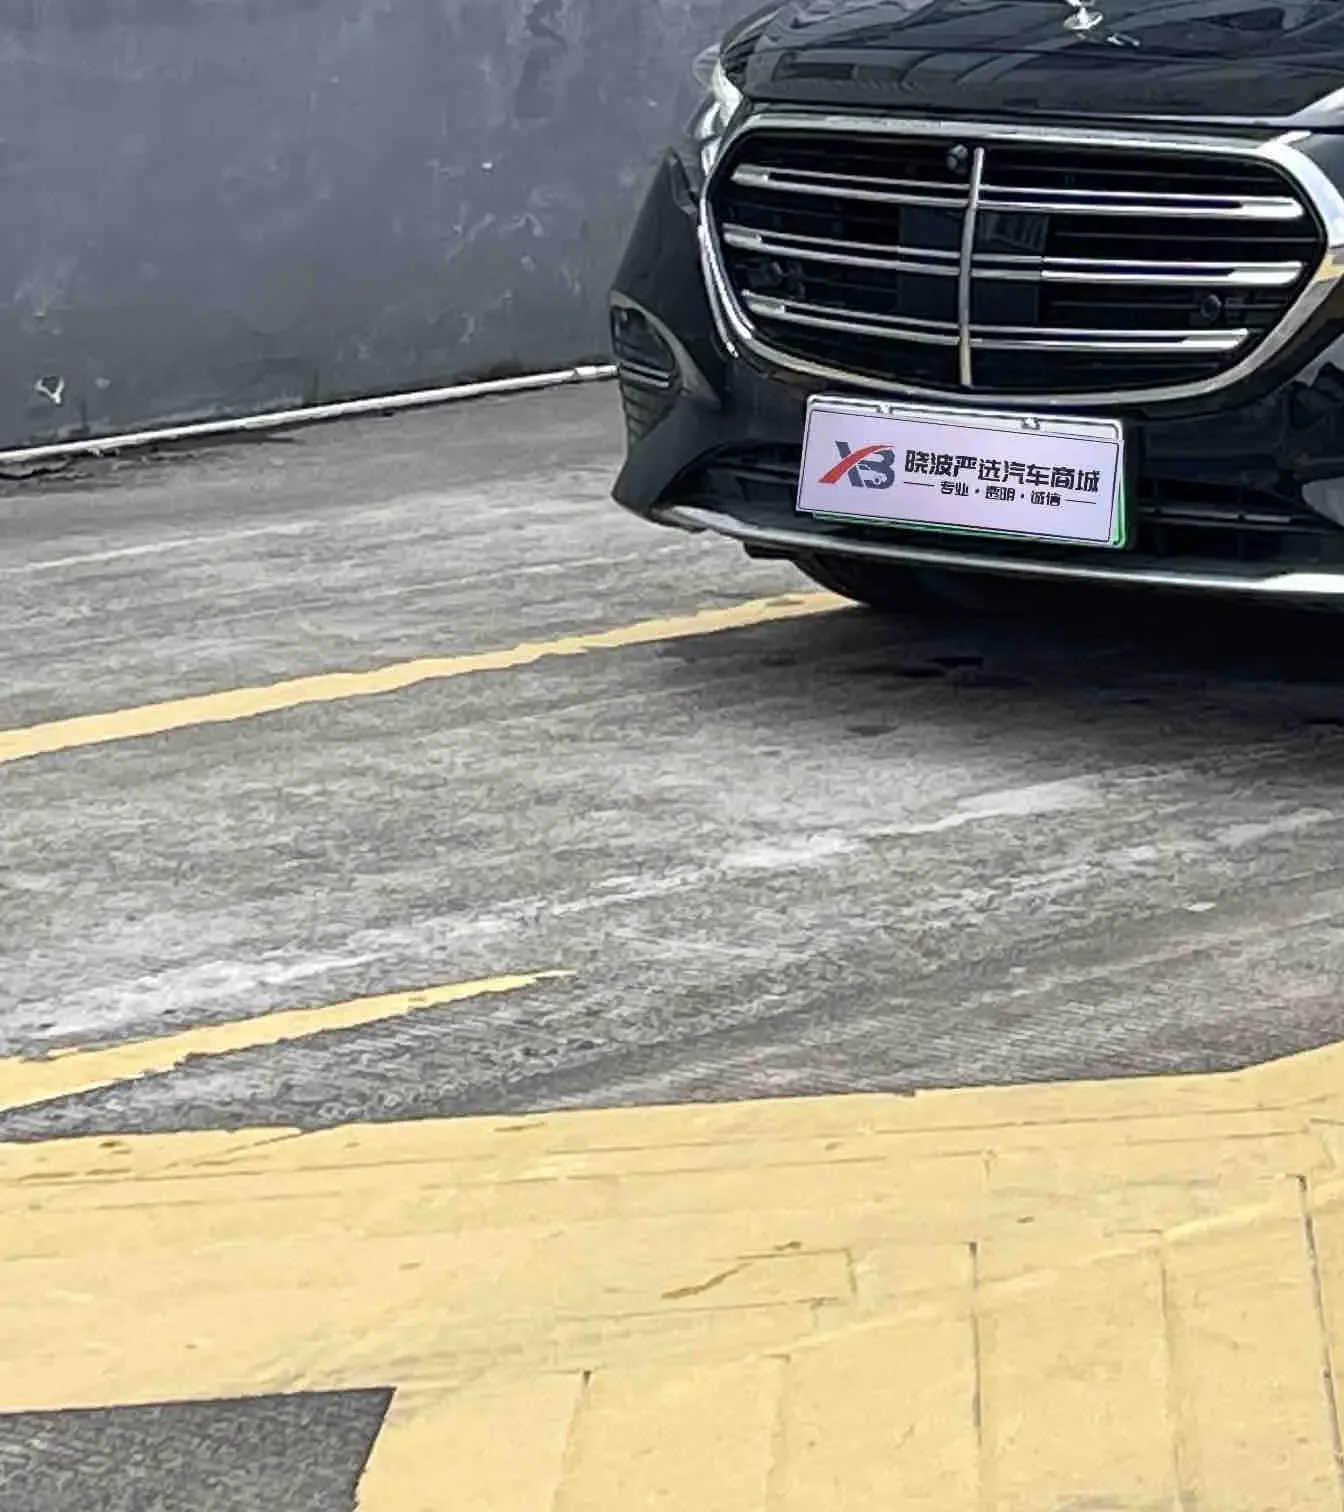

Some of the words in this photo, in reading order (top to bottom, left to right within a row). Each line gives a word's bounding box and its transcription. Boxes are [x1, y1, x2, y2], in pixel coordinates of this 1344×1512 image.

[904, 448, 1101, 494] 晓波严选汽车商城
